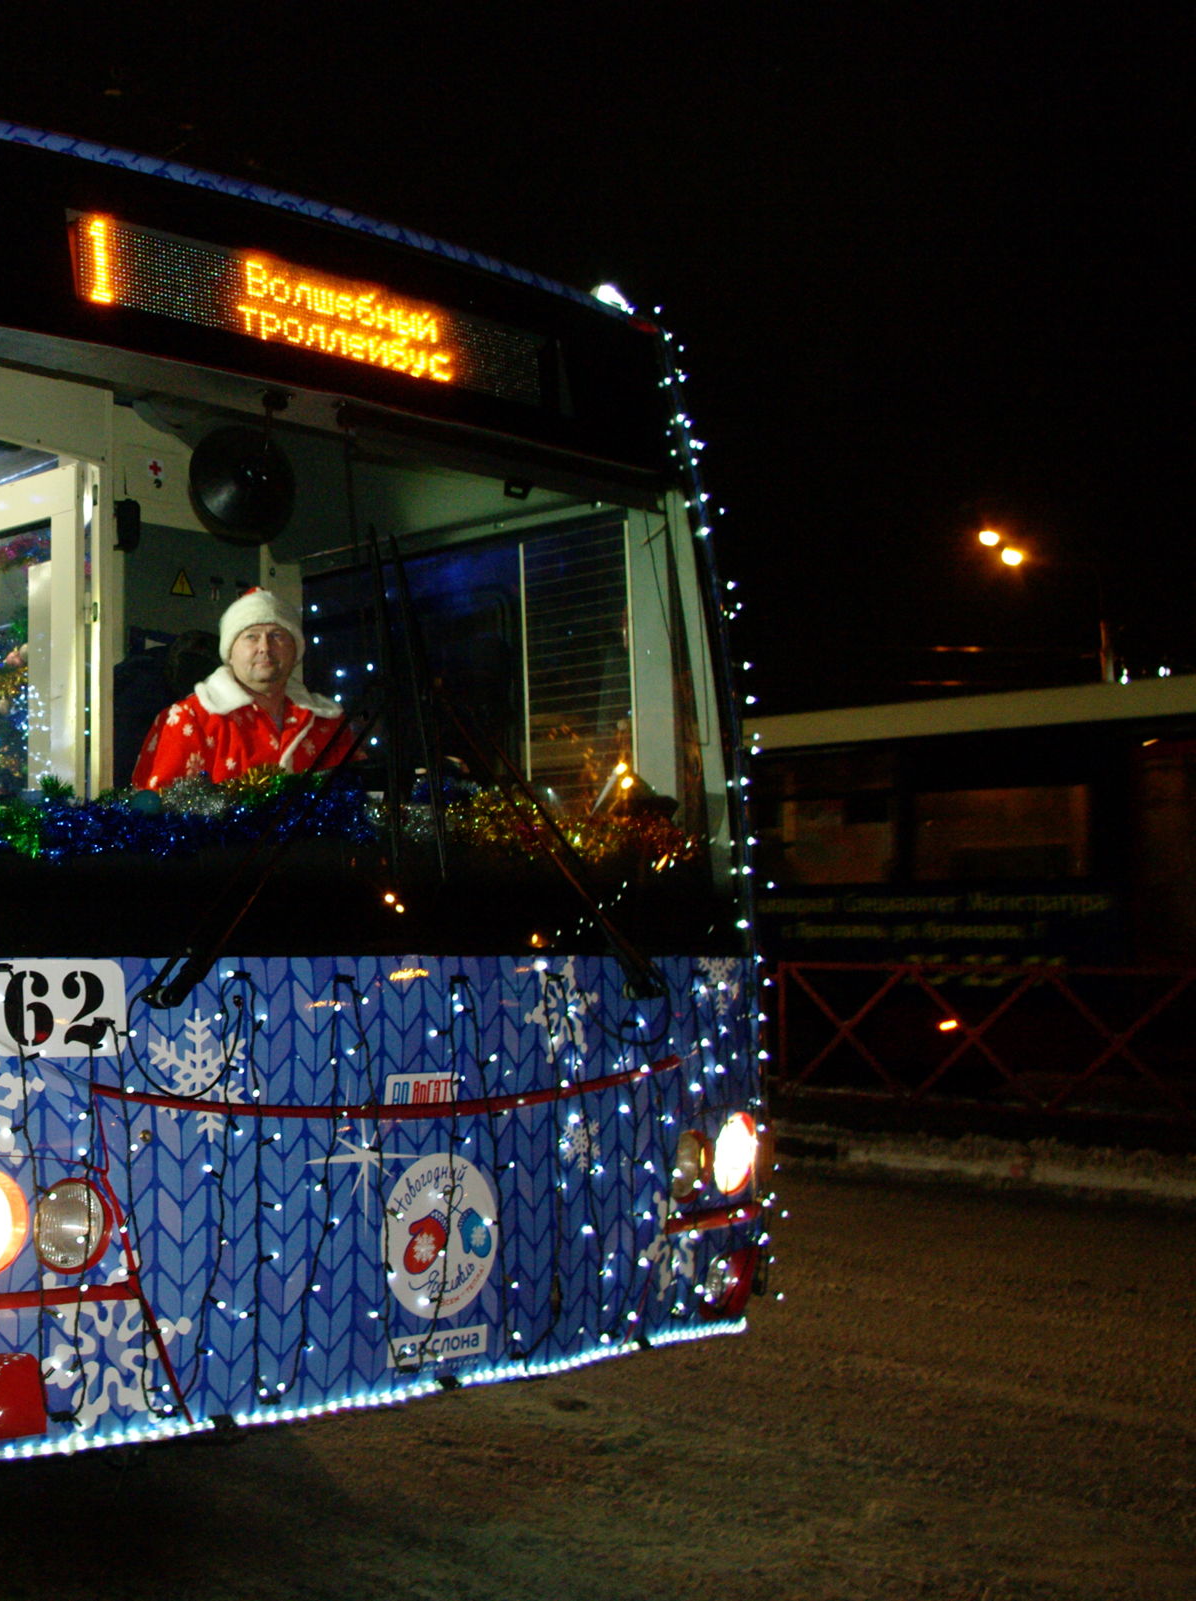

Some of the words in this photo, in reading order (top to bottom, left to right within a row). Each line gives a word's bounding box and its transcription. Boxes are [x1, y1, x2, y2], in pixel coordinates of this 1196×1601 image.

[89, 219, 113, 303] 1
[245, 259, 439, 344] Волшебный
[5, 970, 105, 1047] 62
